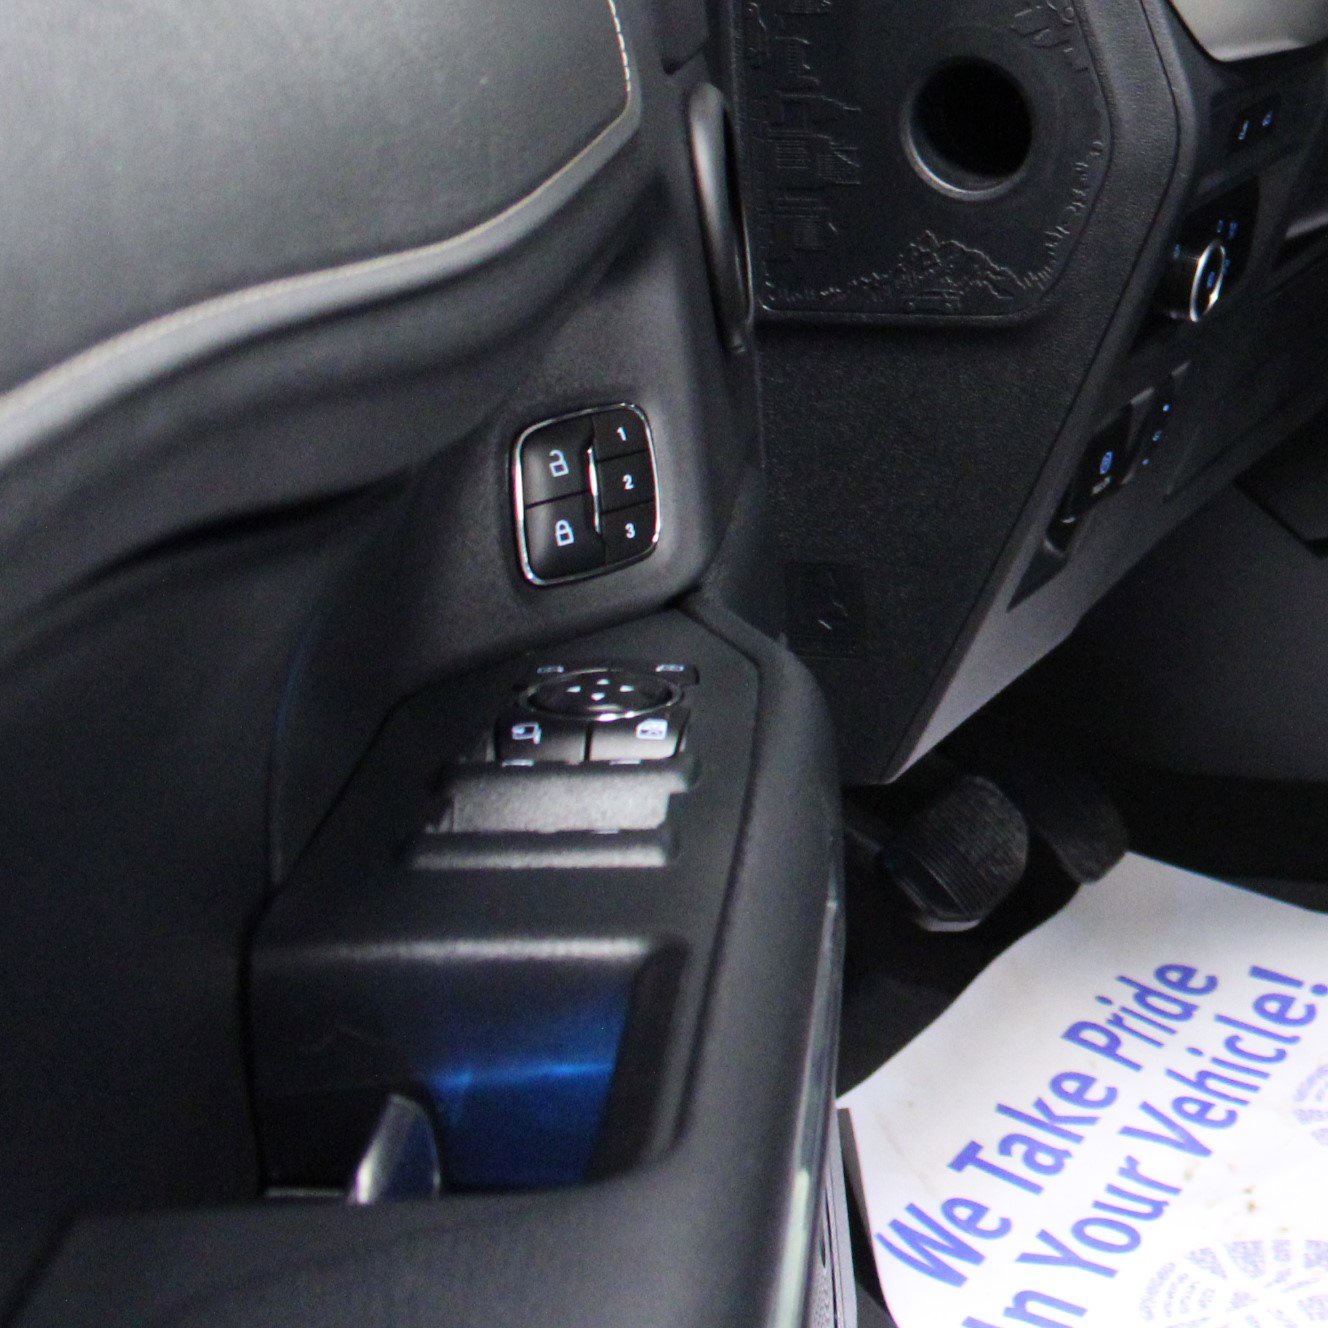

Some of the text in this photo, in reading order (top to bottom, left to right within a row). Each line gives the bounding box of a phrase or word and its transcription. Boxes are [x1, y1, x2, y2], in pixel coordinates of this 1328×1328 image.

[617, 426, 627, 441] 1
[622, 474, 634, 490] 2
[624, 522, 636, 539] 3
[875, 962, 1218, 1289] We Take Pride
[1015, 1154, 1183, 1278] Your
